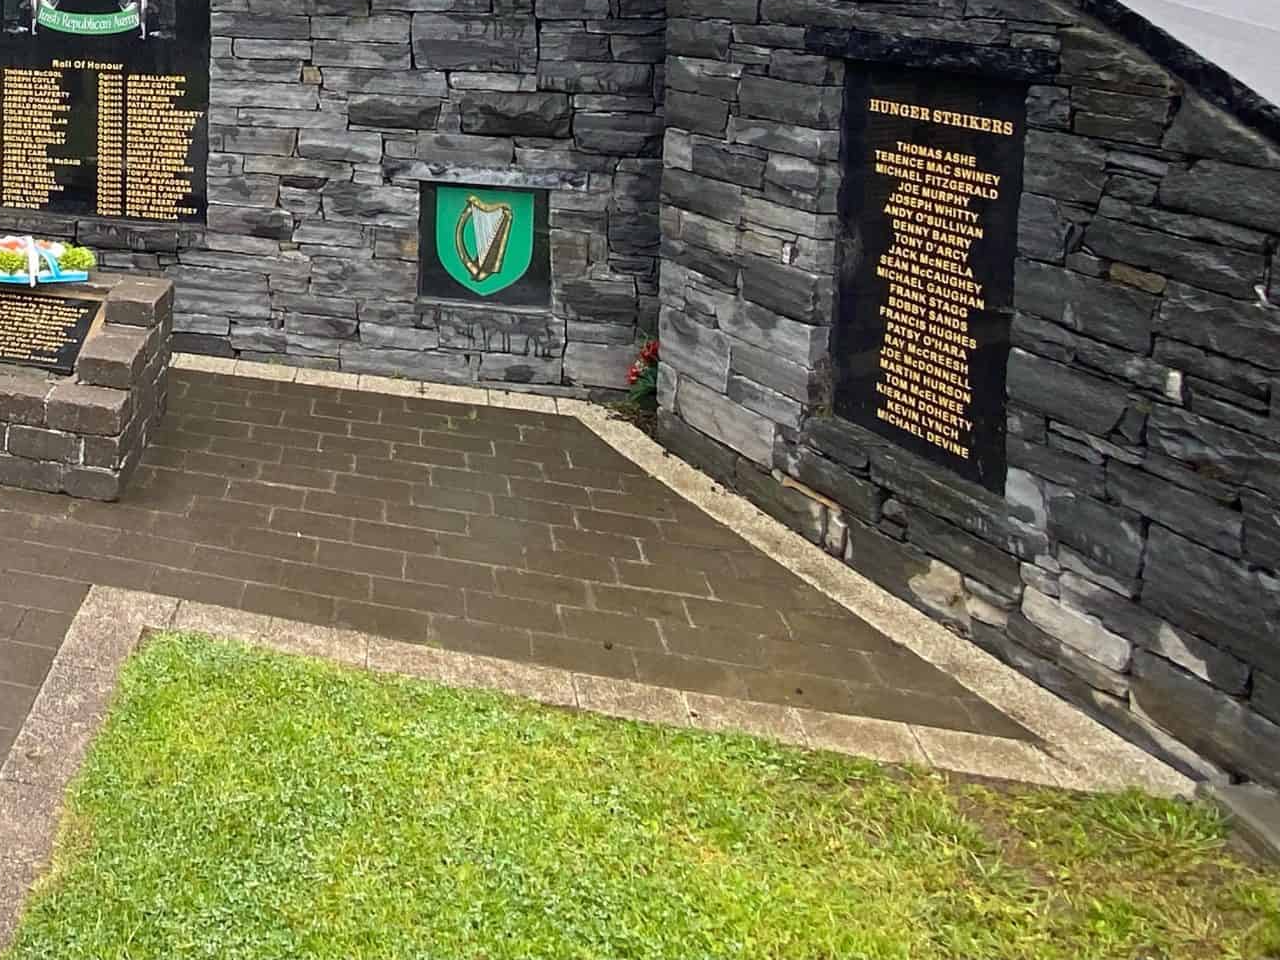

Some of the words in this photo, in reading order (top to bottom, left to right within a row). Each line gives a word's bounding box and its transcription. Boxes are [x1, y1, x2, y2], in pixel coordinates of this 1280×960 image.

[38, 7, 61, 25] Irish
[63, 13, 112, 32] Republican
[52, 59, 72, 68] Roll
[73, 60, 86, 69] Of
[87, 61, 124, 70] Honour
[870, 102, 930, 121] HUNGER
[933, 111, 1013, 135] STRIKERS
[876, 151, 924, 170] TERENCE
[926, 161, 951, 176] MAC
[953, 167, 1000, 186] SWINEY
[897, 142, 942, 160] THOMAS
[944, 151, 976, 167] ASHE
[875, 164, 923, 183] MICHAEL
[925, 174, 998, 200] FITZGERALD
[898, 182, 919, 196] JOE
[922, 187, 970, 207] MURPHY
[884, 205, 913, 221] ANDY
[915, 212, 983, 239] O'SULLIVAN
[889, 193, 932, 212] JOSEPH
[934, 203, 978, 223] WHITTY
[893, 220, 929, 239] DENNY
[932, 230, 972, 250] BARRY
[895, 234, 923, 250] TONY
[926, 242, 968, 263] D'ARCY
[889, 245, 917, 262] JACK
[920, 254, 973, 278] McNEELA
[877, 268, 924, 291] MICHAEL
[927, 282, 984, 309] GAUGHAN
[911, 265, 982, 295] McCAUGHEY
[889, 297, 926, 319] BOBBY
[929, 310, 968, 332] SANDS
[890, 285, 926, 305] FRANK
[929, 297, 968, 318] STAGG
[880, 307, 926, 332] FRANCIS
[929, 324, 977, 349] HUGHES
[887, 323, 920, 344] PATSY
[923, 335, 967, 360] O'HARA
[880, 346, 901, 363] JOE
[904, 355, 970, 389] McDONNELL
[885, 335, 905, 351] RAY
[907, 343, 968, 374] McCREESH
[880, 359, 920, 384] MARTIN
[923, 375, 971, 403] HURSON
[886, 375, 908, 392] TOM
[910, 384, 963, 414] McELWEE
[876, 384, 915, 408] KIERAN
[918, 400, 972, 431] DOHERTY
[887, 401, 919, 423] KEVIN
[922, 415, 959, 440] LYNCH
[877, 410, 924, 439] MICHAEL
[927, 431, 969, 458] DEVINE
